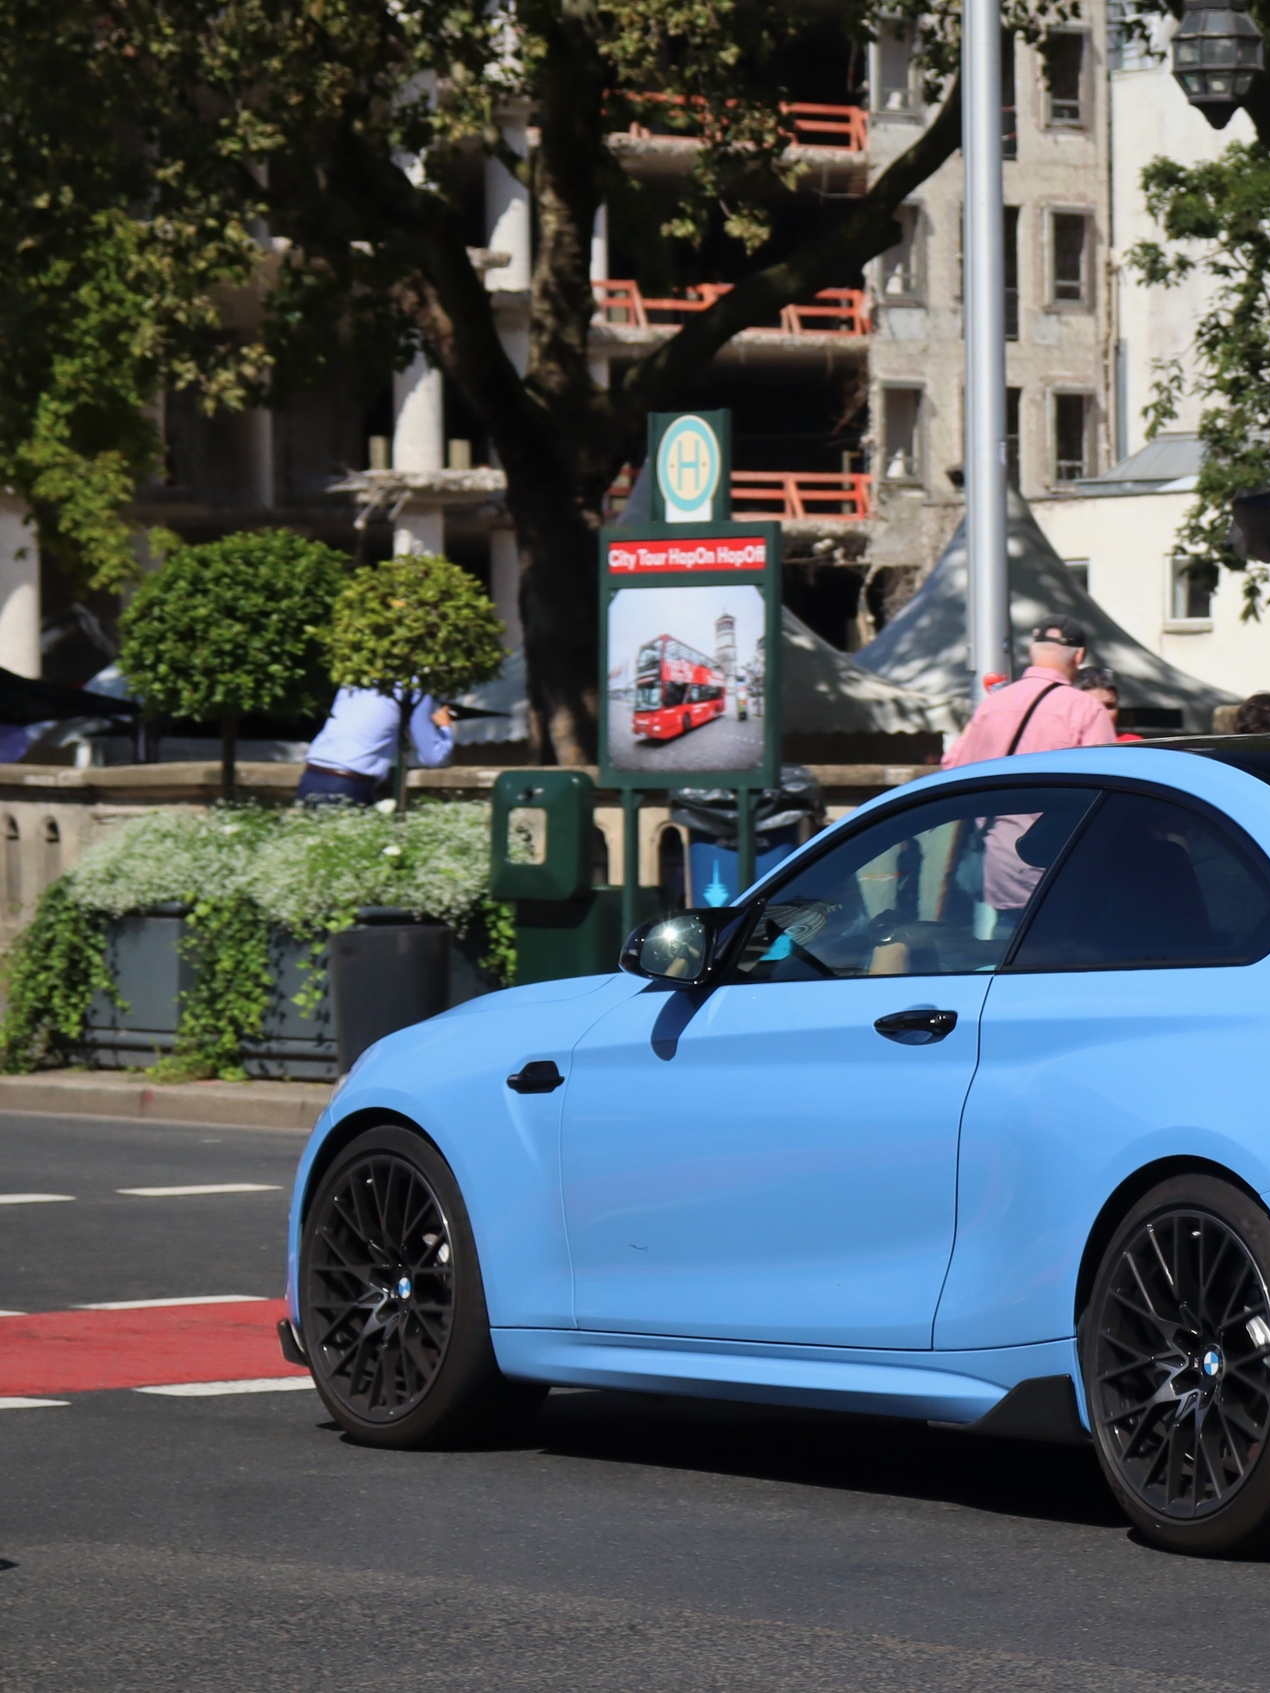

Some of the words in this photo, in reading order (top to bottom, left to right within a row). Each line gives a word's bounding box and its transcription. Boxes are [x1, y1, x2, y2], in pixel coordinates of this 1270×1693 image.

[677, 440, 700, 491] H
[608, 549, 637, 570] City
[637, 548, 667, 566] Tour
[667, 547, 715, 568] HopOn
[716, 545, 767, 567] HopOff
